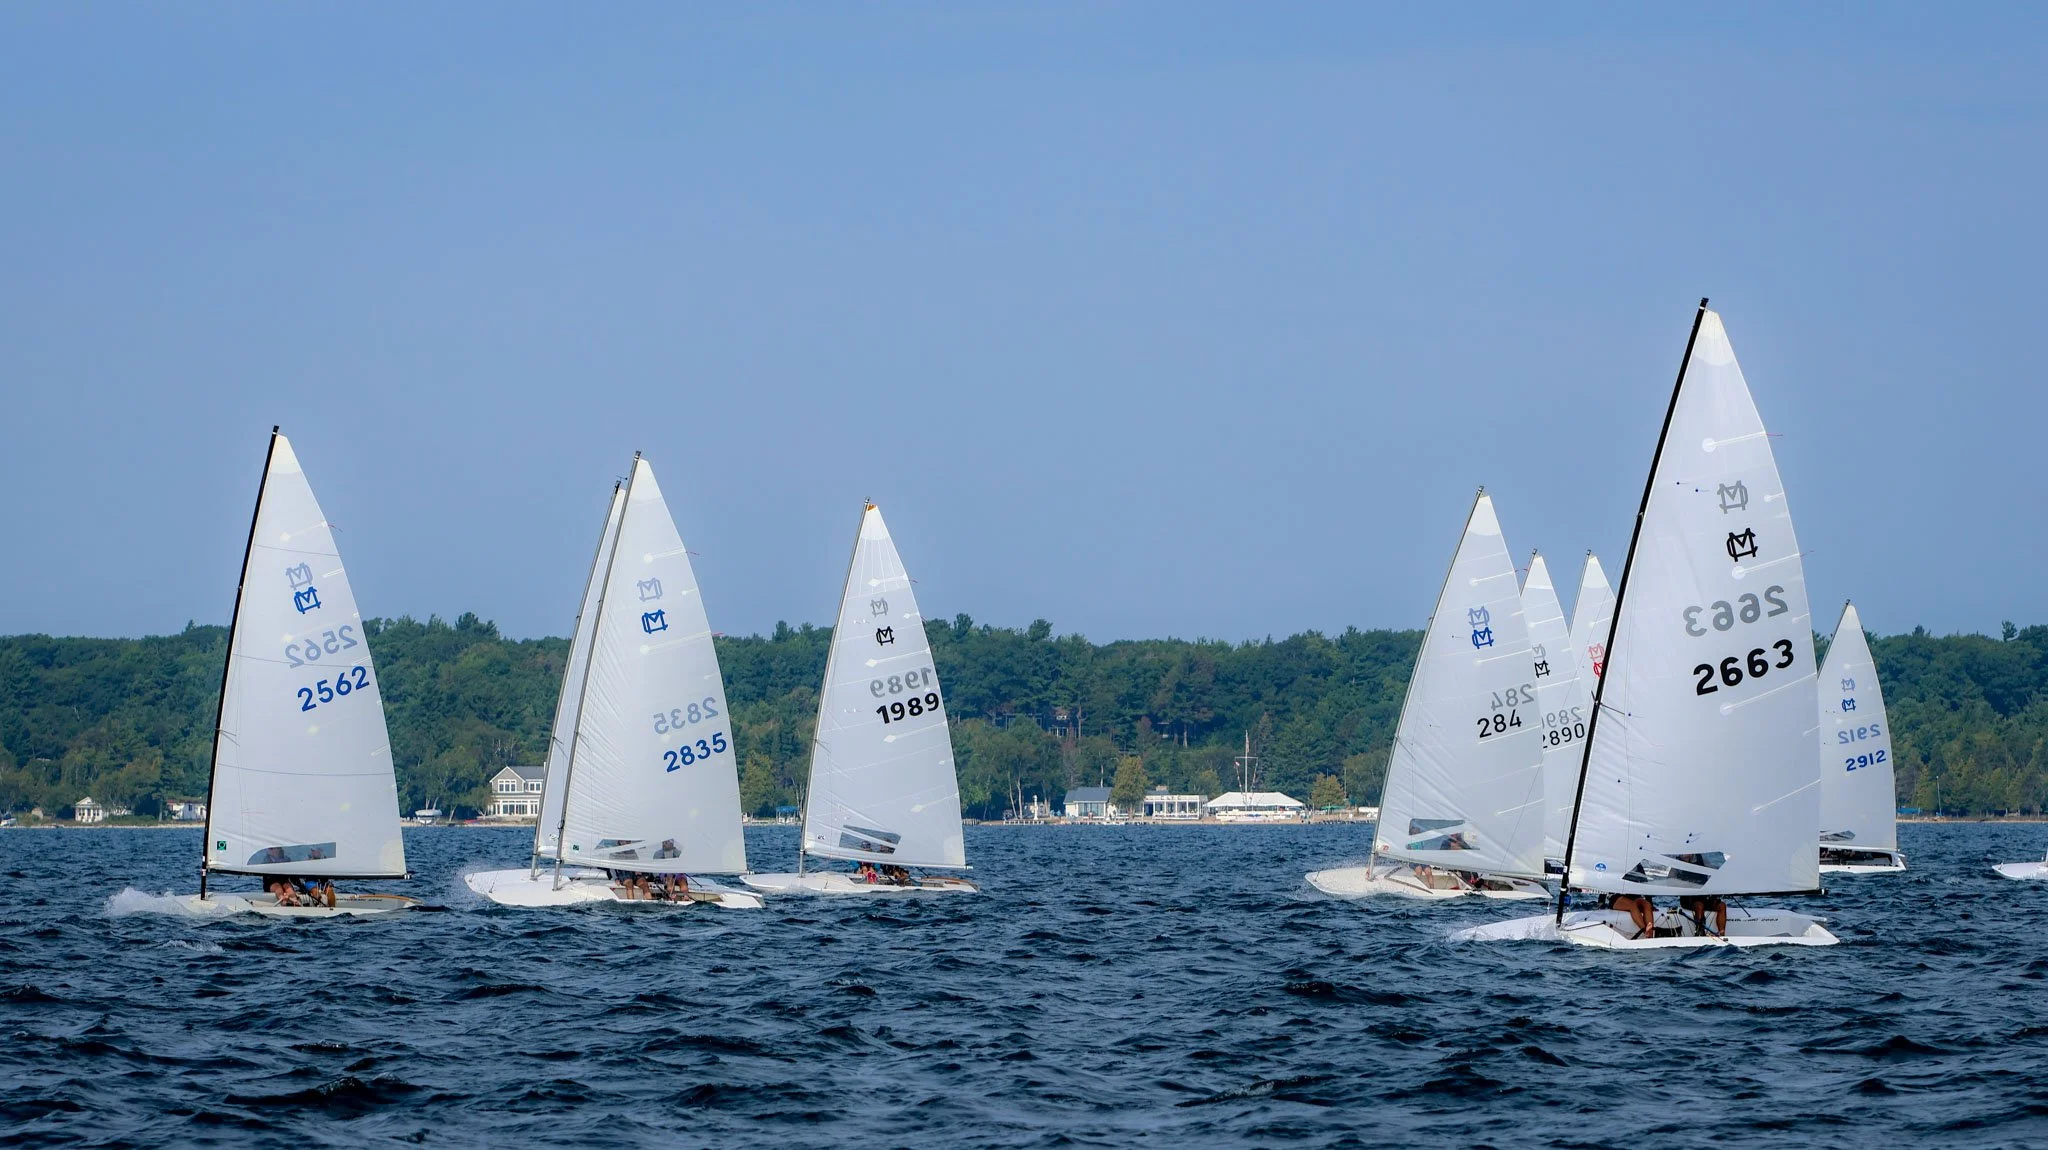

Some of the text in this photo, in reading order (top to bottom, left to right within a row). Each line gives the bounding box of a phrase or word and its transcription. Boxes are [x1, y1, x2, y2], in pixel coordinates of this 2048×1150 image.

[1692, 638, 1795, 697] 2663
[297, 666, 370, 712] 2562
[875, 692, 940, 724] 1989
[1476, 709, 1522, 738] 284
[663, 732, 727, 773] 2835
[1845, 749, 1887, 772] 2912
